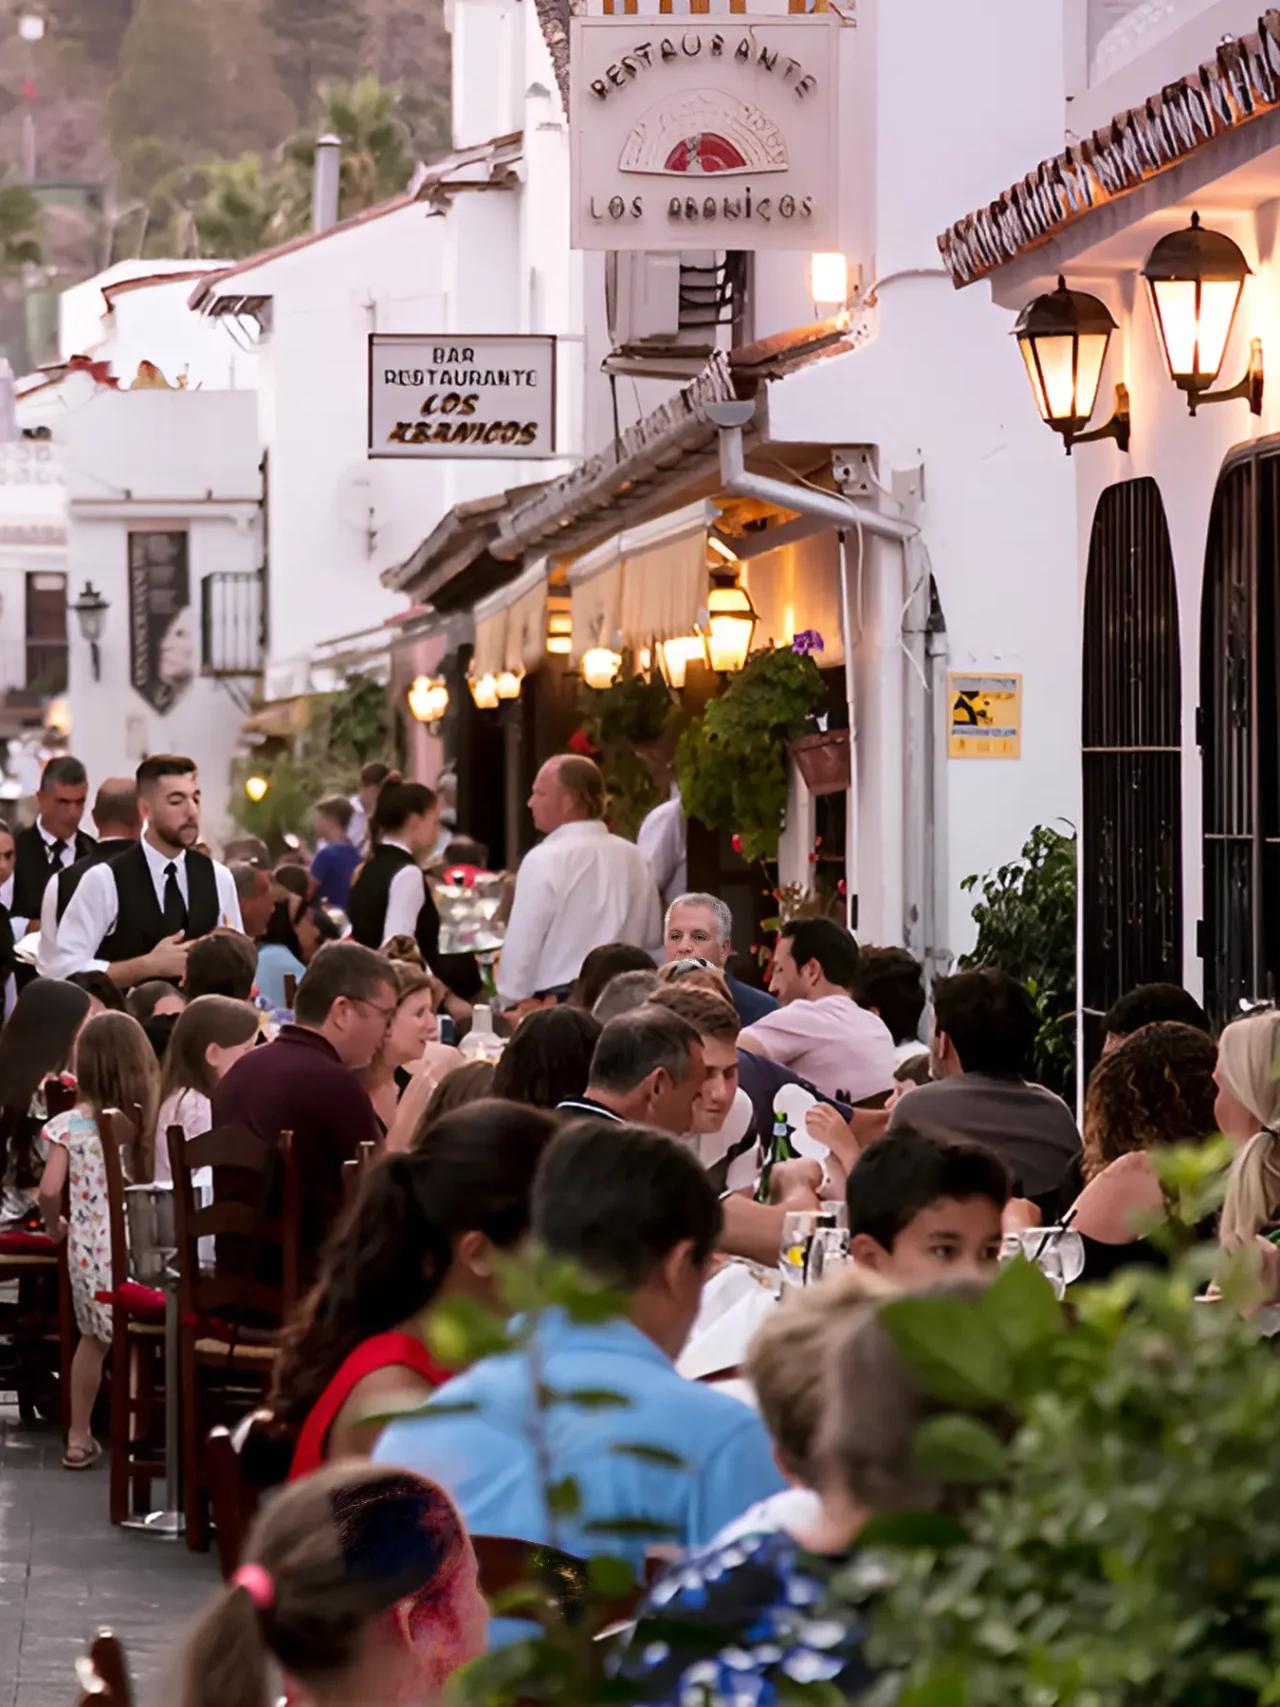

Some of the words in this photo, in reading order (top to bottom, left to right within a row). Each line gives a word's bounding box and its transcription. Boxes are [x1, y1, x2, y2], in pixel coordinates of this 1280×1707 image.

[589, 33, 818, 101] RESTAURANTE
[590, 195, 643, 220] LOS
[432, 347, 475, 365] BAR
[384, 369, 538, 388] RESTAURANTE
[419, 392, 480, 418] LOS
